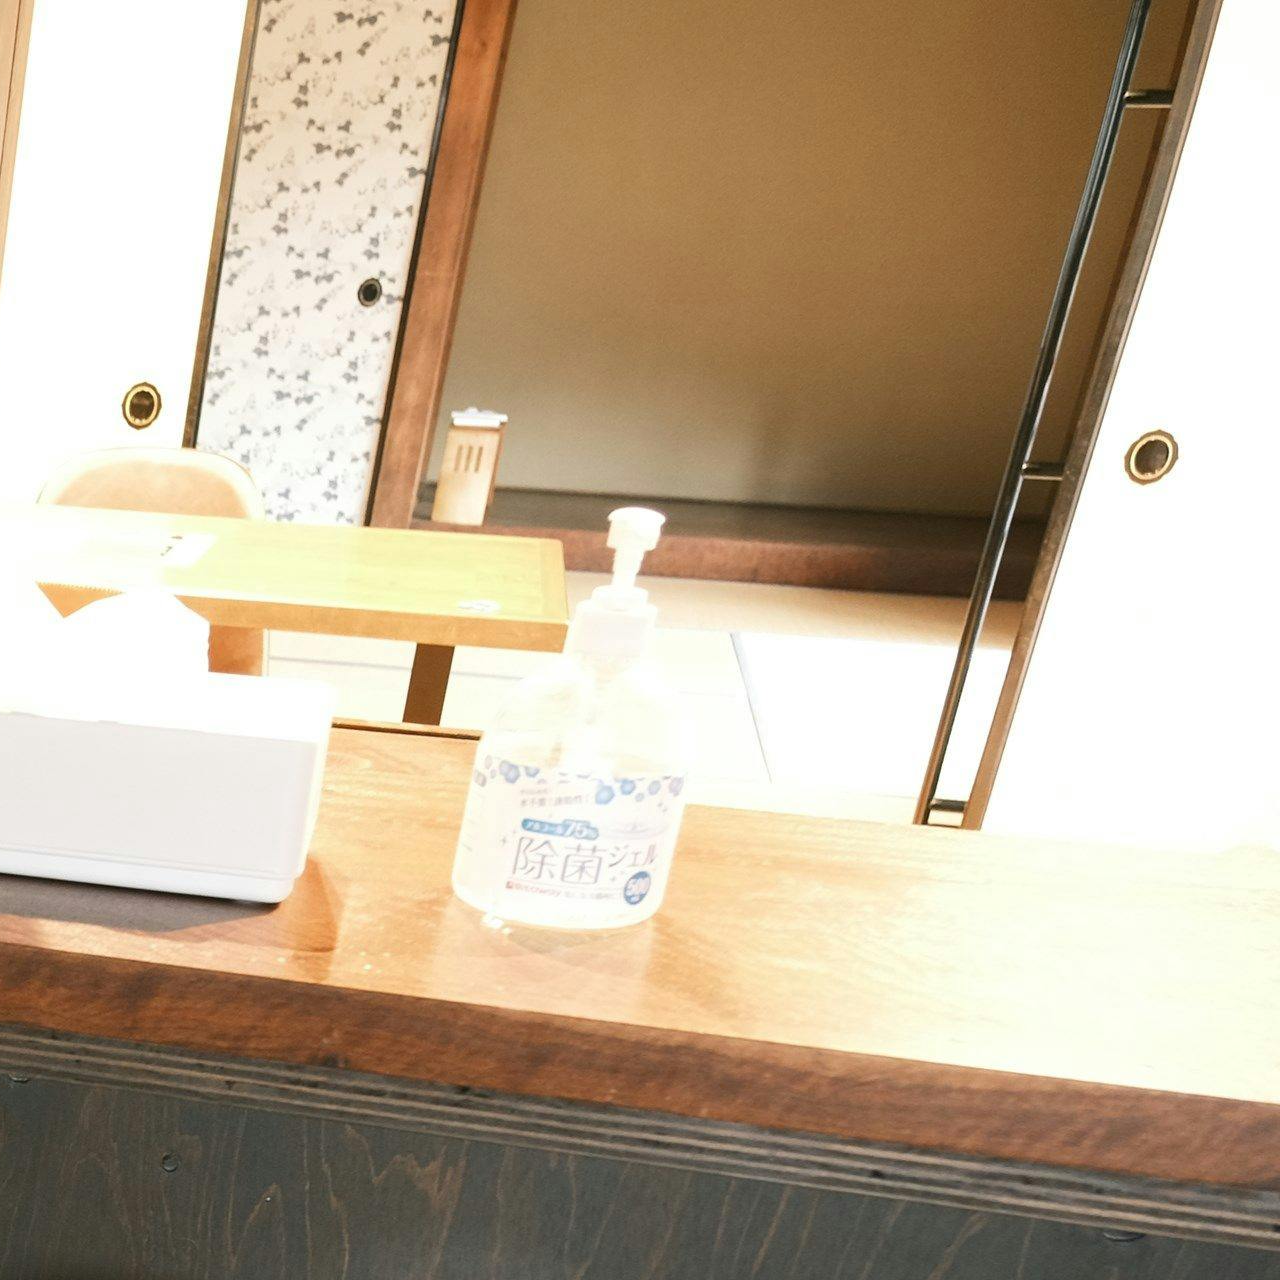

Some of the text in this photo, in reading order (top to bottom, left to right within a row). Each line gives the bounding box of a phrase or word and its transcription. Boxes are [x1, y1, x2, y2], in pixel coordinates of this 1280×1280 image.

[513, 836, 658, 885] 除菌ジェル
